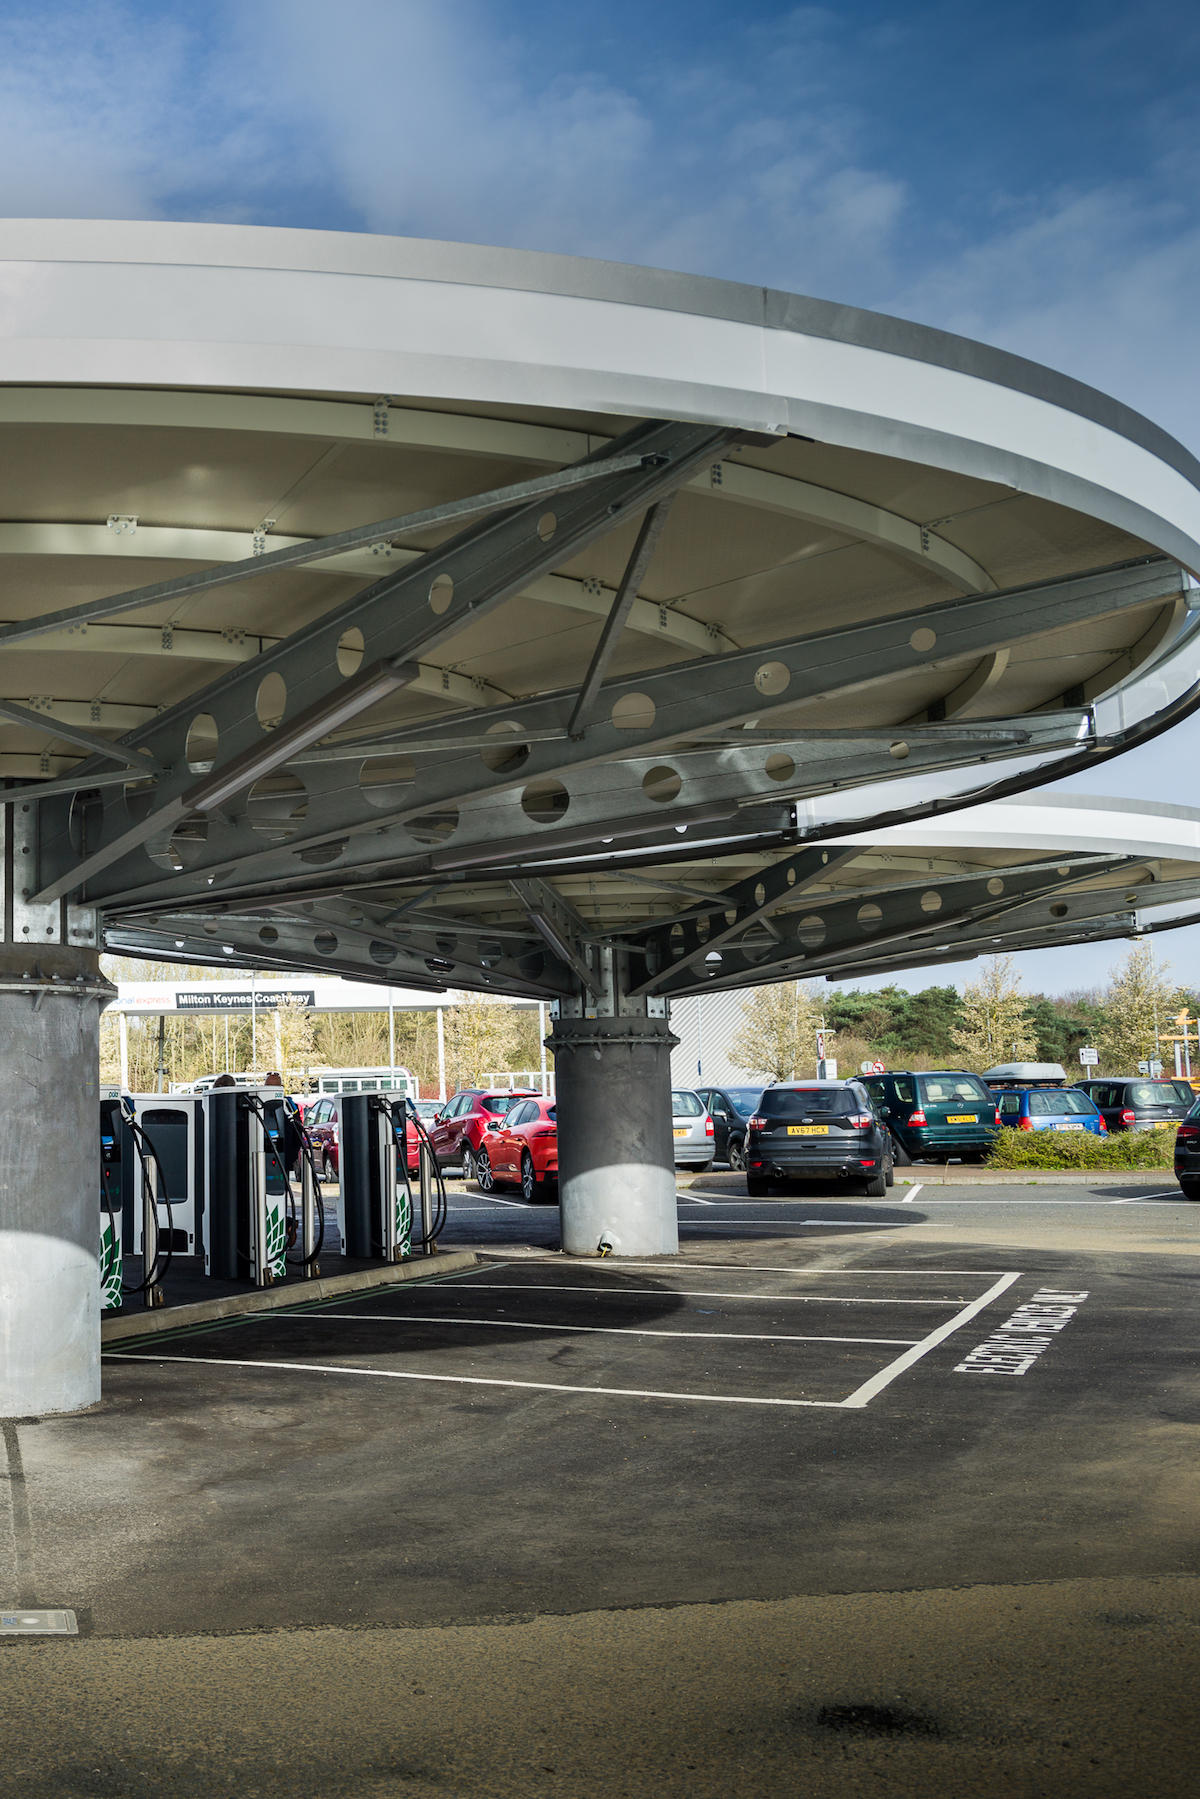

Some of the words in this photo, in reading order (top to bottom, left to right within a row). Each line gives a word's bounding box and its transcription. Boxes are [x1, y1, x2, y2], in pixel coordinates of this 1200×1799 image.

[178, 994, 211, 1004] Milton
[213, 994, 253, 1006] Keynes
[790, 1126, 810, 1134] AV67
[812, 1126, 826, 1134] HCX
